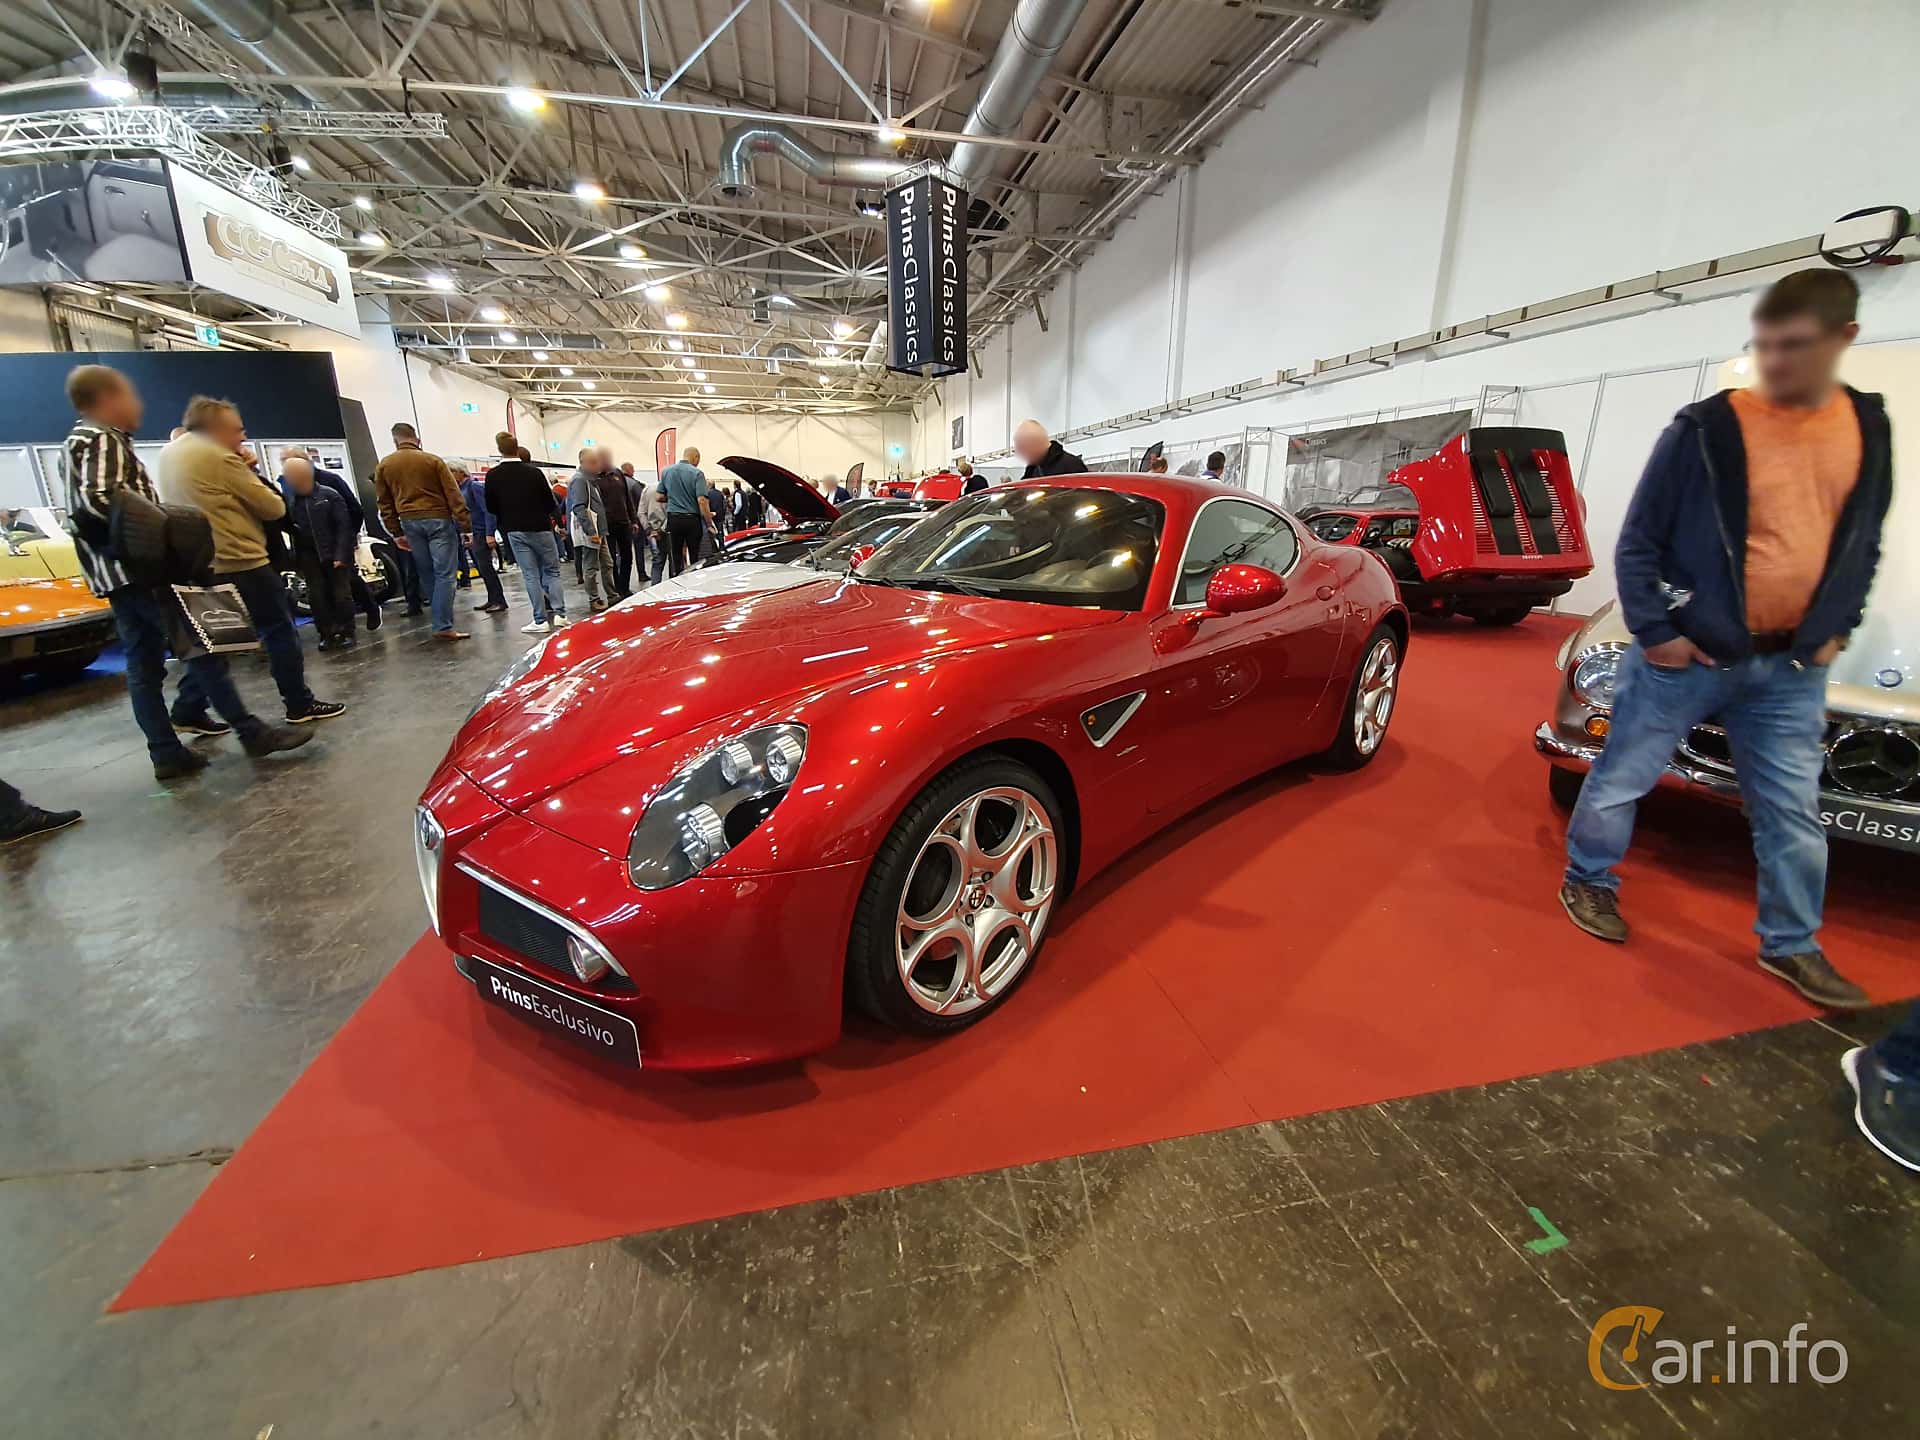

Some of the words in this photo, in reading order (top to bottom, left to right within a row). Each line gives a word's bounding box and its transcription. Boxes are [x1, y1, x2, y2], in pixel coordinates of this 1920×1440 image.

[899, 185, 920, 364] PrinsClassics
[941, 184, 958, 363] PrinsClassics
[489, 975, 614, 1046] PrinsEsclusivo
